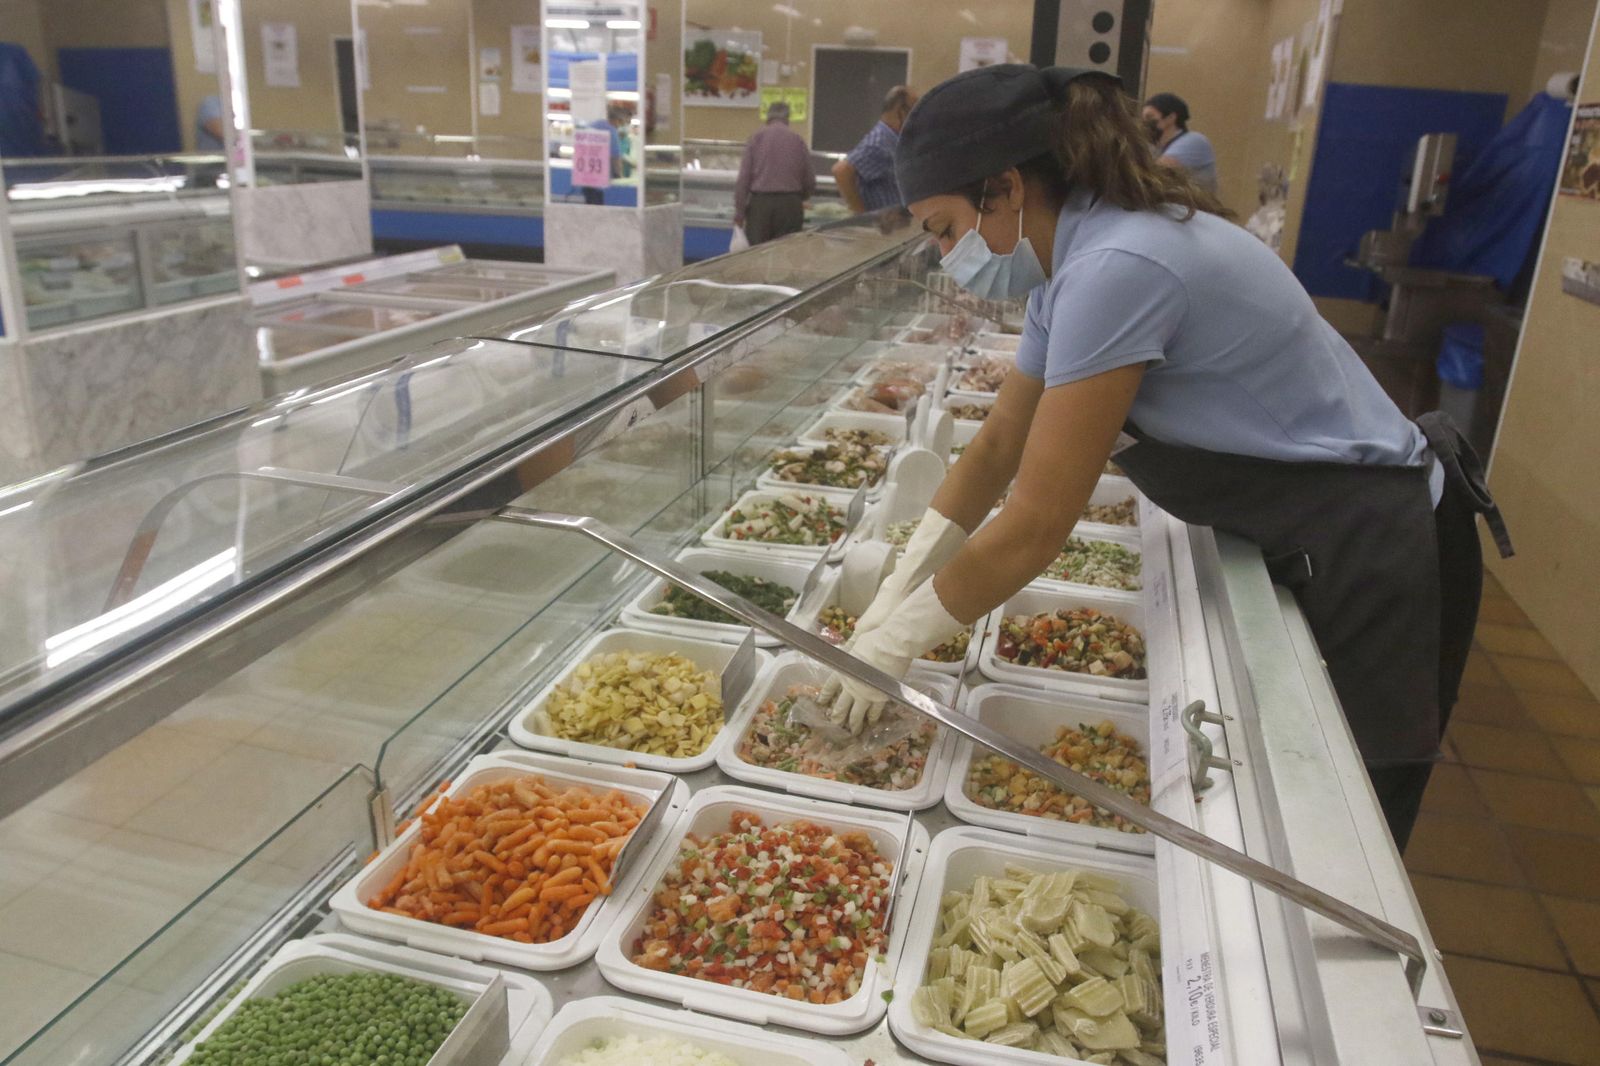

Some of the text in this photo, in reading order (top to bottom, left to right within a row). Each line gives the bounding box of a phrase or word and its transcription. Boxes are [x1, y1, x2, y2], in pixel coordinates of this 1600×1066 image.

[1203, 982, 1213, 992] DE
[1204, 993, 1216, 1021] VERDURA
[1207, 1021, 1220, 1052] ESPECIAL
